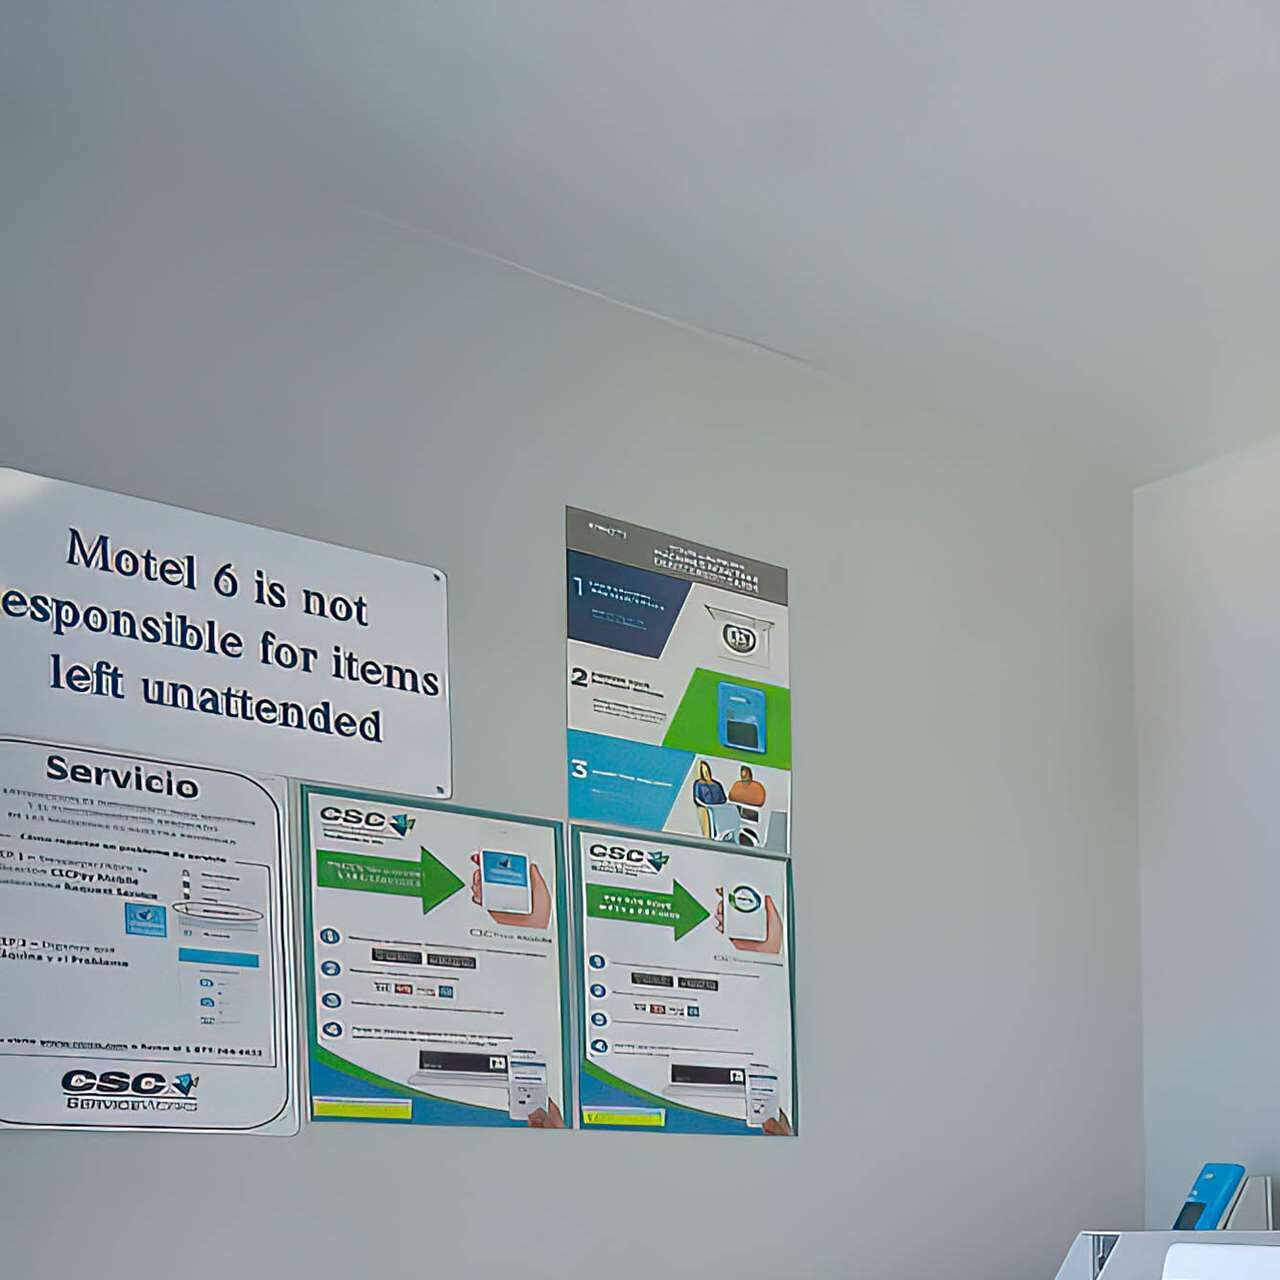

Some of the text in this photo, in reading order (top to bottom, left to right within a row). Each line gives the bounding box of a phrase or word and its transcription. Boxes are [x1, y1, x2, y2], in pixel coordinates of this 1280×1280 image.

[66, 527, 369, 627] Motel 6 is not
[572, 576, 583, 597] 1
[0, 587, 440, 697] esponsible for items
[571, 667, 589, 688] 2
[49, 654, 385, 743] left unattended
[46, 754, 201, 800] Servicio
[571, 758, 589, 779] 3
[319, 806, 387, 829] CSC
[588, 843, 645, 864] CSC
[61, 1068, 167, 1096] CSC
